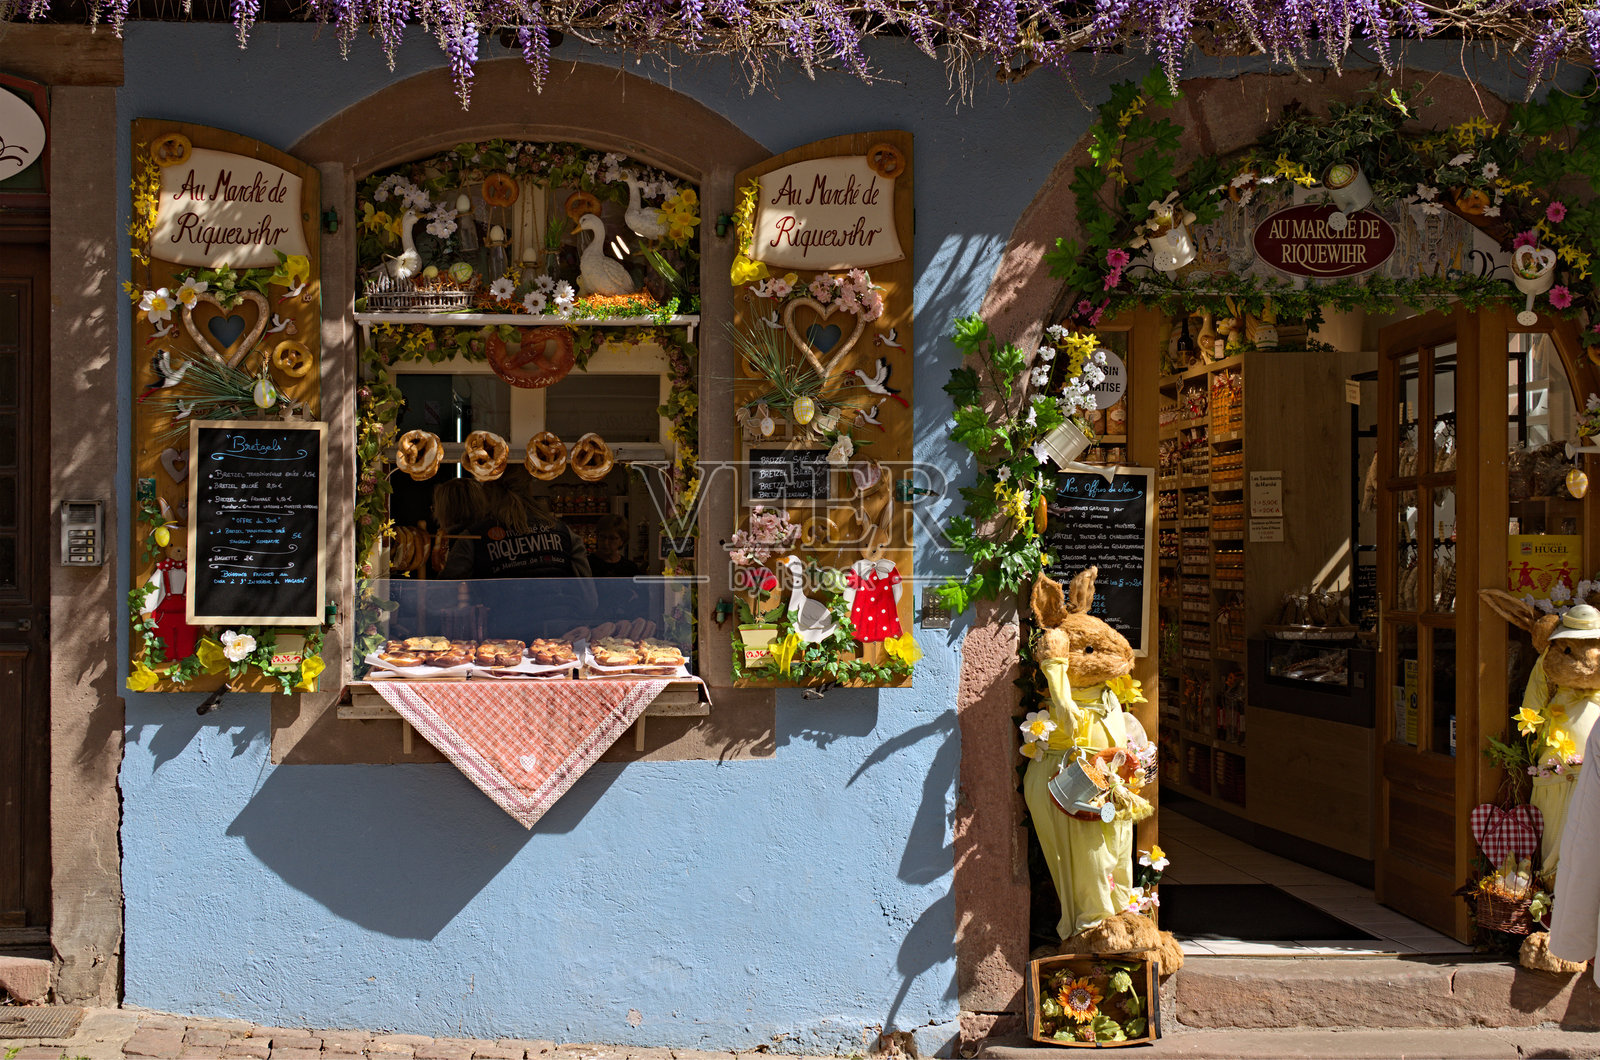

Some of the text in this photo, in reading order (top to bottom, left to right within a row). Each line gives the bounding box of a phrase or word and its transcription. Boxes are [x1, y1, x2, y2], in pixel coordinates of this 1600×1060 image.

[173, 169, 287, 204] Au Marché de
[772, 174, 880, 206] Au Marché de
[170, 212, 288, 256] Riquewihr
[770, 216, 882, 258] Riquewihr
[1268, 214, 1380, 239] AU MARCHÉ DE
[1281, 244, 1368, 272] RIQUEWIHR
[487, 533, 564, 561] RIQUEWIHR
